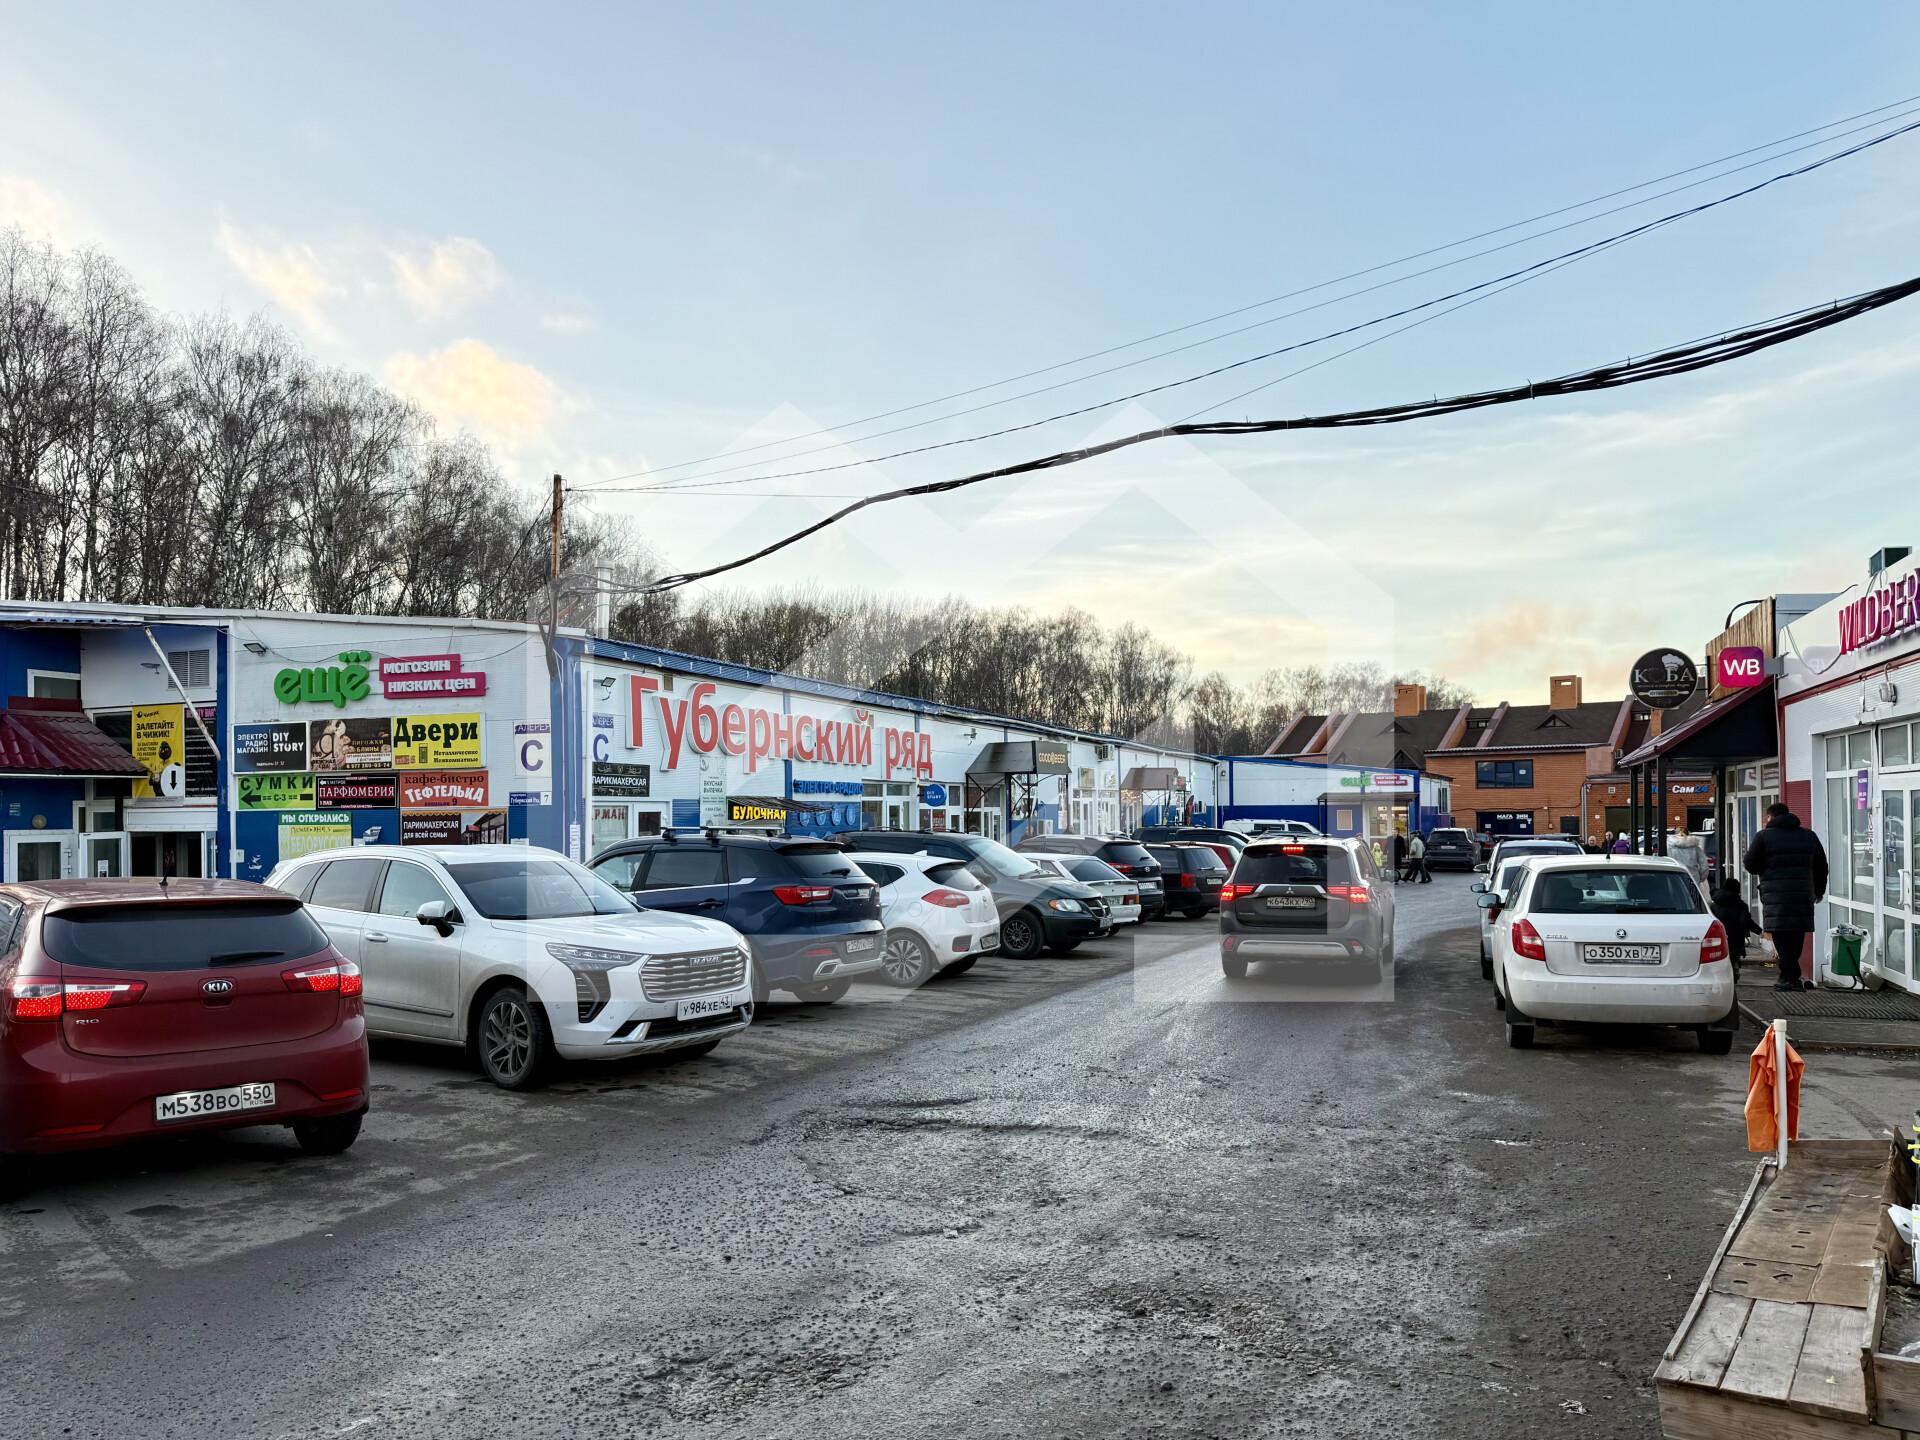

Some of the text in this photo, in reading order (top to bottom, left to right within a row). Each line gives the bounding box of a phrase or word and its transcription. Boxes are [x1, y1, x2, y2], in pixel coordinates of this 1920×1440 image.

[384, 660, 450, 674] магазин
[1723, 658, 1760, 676] WB
[273, 650, 372, 708] ещё
[1634, 667, 1695, 683] КБА
[388, 678, 475, 693] низких цен
[136, 720, 175, 730] ЗАЛЕТАЙТЕ
[624, 673, 934, 782] Губернский ряд
[143, 730, 170, 738] ЧИЖИК!
[272, 732, 289, 742] DIY
[393, 717, 478, 748] Двери
[273, 742, 304, 752] STORY
[240, 776, 313, 790] СУМКИ
[404, 774, 484, 785] кафе-бистро
[592, 775, 647, 786] ПАРИКМАХЕРСКАЯ
[319, 786, 394, 797] ПАРФЮМЕРИЯ
[405, 785, 484, 803] ТЕФТЕЛЬКА
[452, 798, 457, 806] 9
[544, 794, 549, 803] 7
[281, 813, 350, 823] МЫ ОТКРЫЛИСЬ
[733, 805, 787, 820] БУЛОЧНАЯ
[403, 820, 458, 829] ПАРИКМАХЕРСКАЯ
[415, 830, 428, 838] всей
[1643, 946, 1655, 956] 77
[208, 982, 231, 991] KIA
[162, 1085, 271, 1117] М538ВО 550
